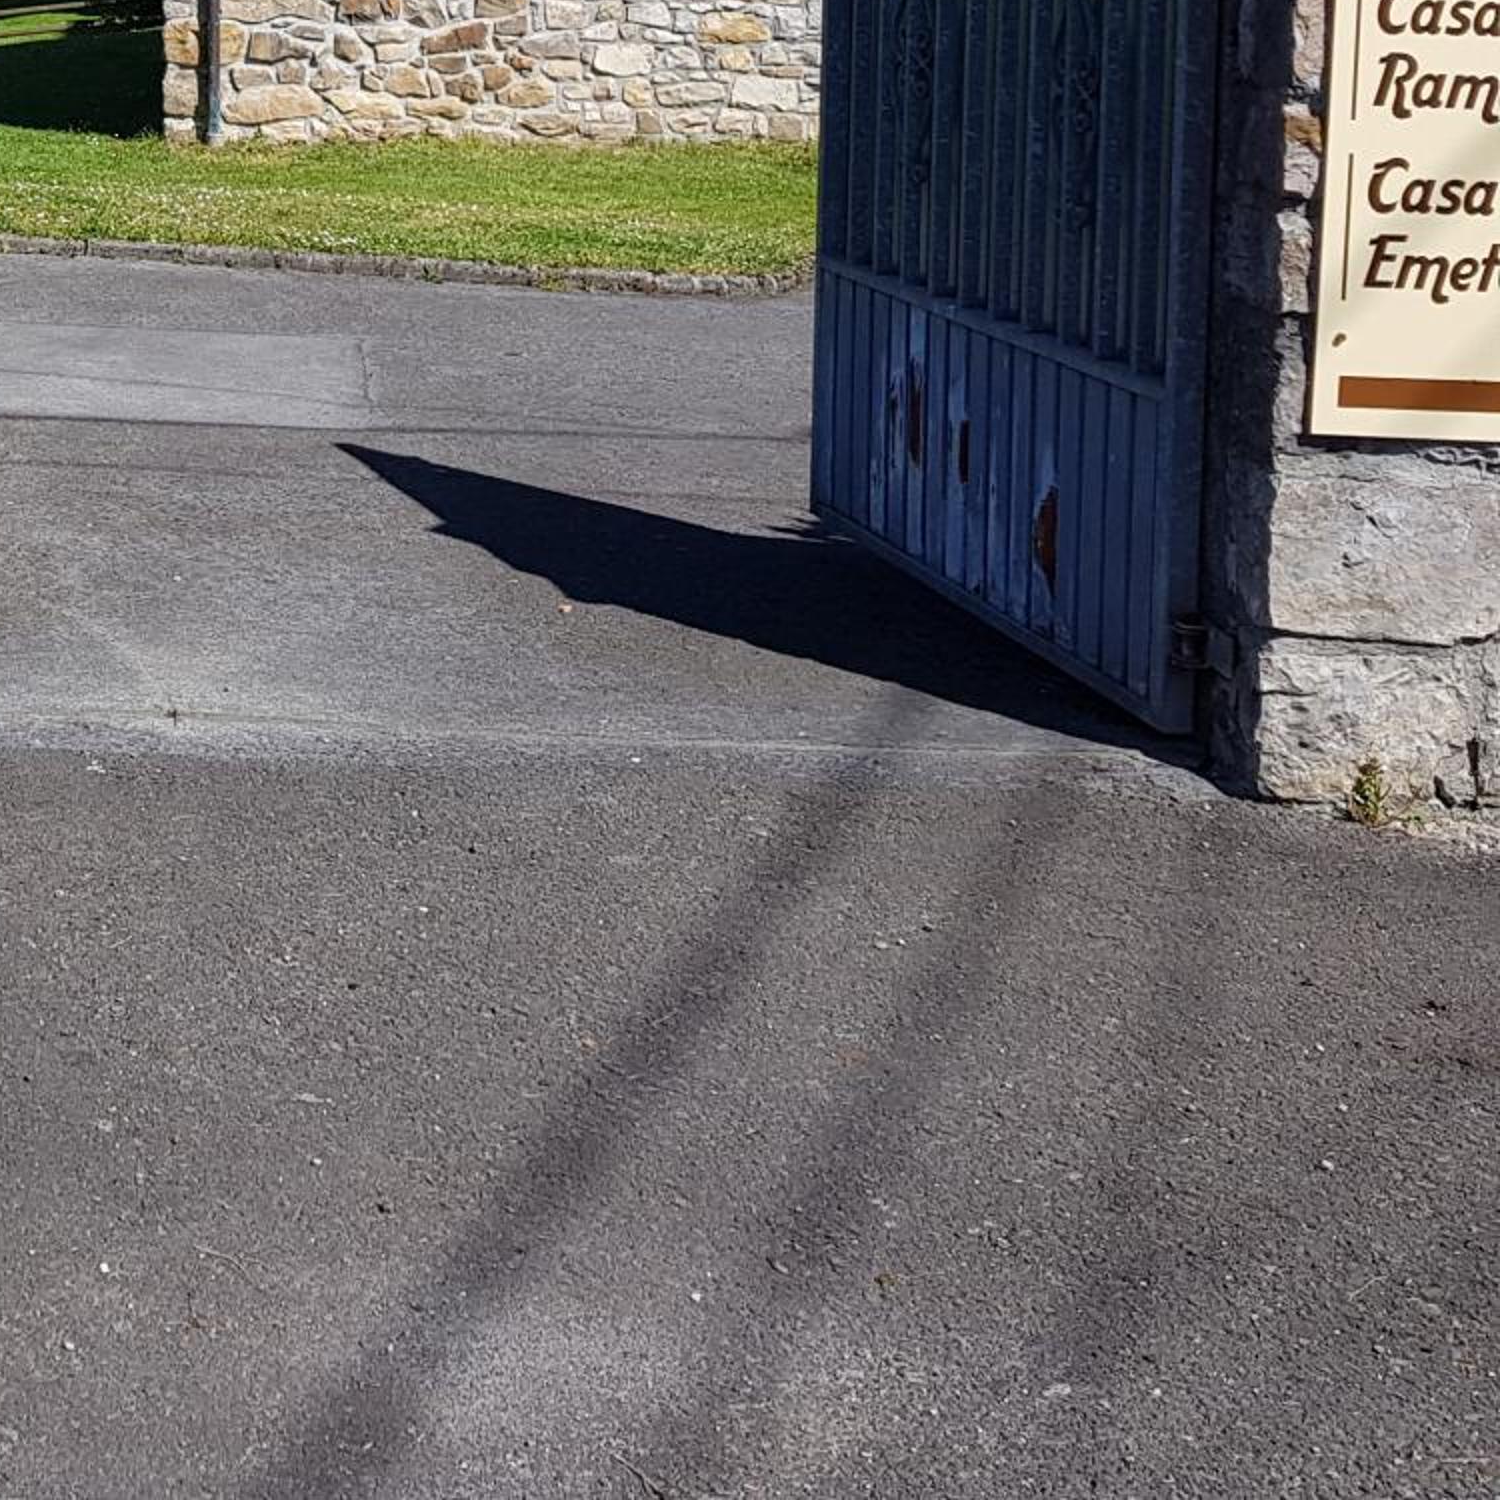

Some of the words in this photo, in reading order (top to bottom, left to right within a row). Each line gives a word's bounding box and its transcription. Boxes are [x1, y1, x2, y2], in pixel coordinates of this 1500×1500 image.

[1373, 52, 1500, 125] Ram
[1367, 157, 1499, 217] Casa
[1363, 233, 1500, 304] Emet
